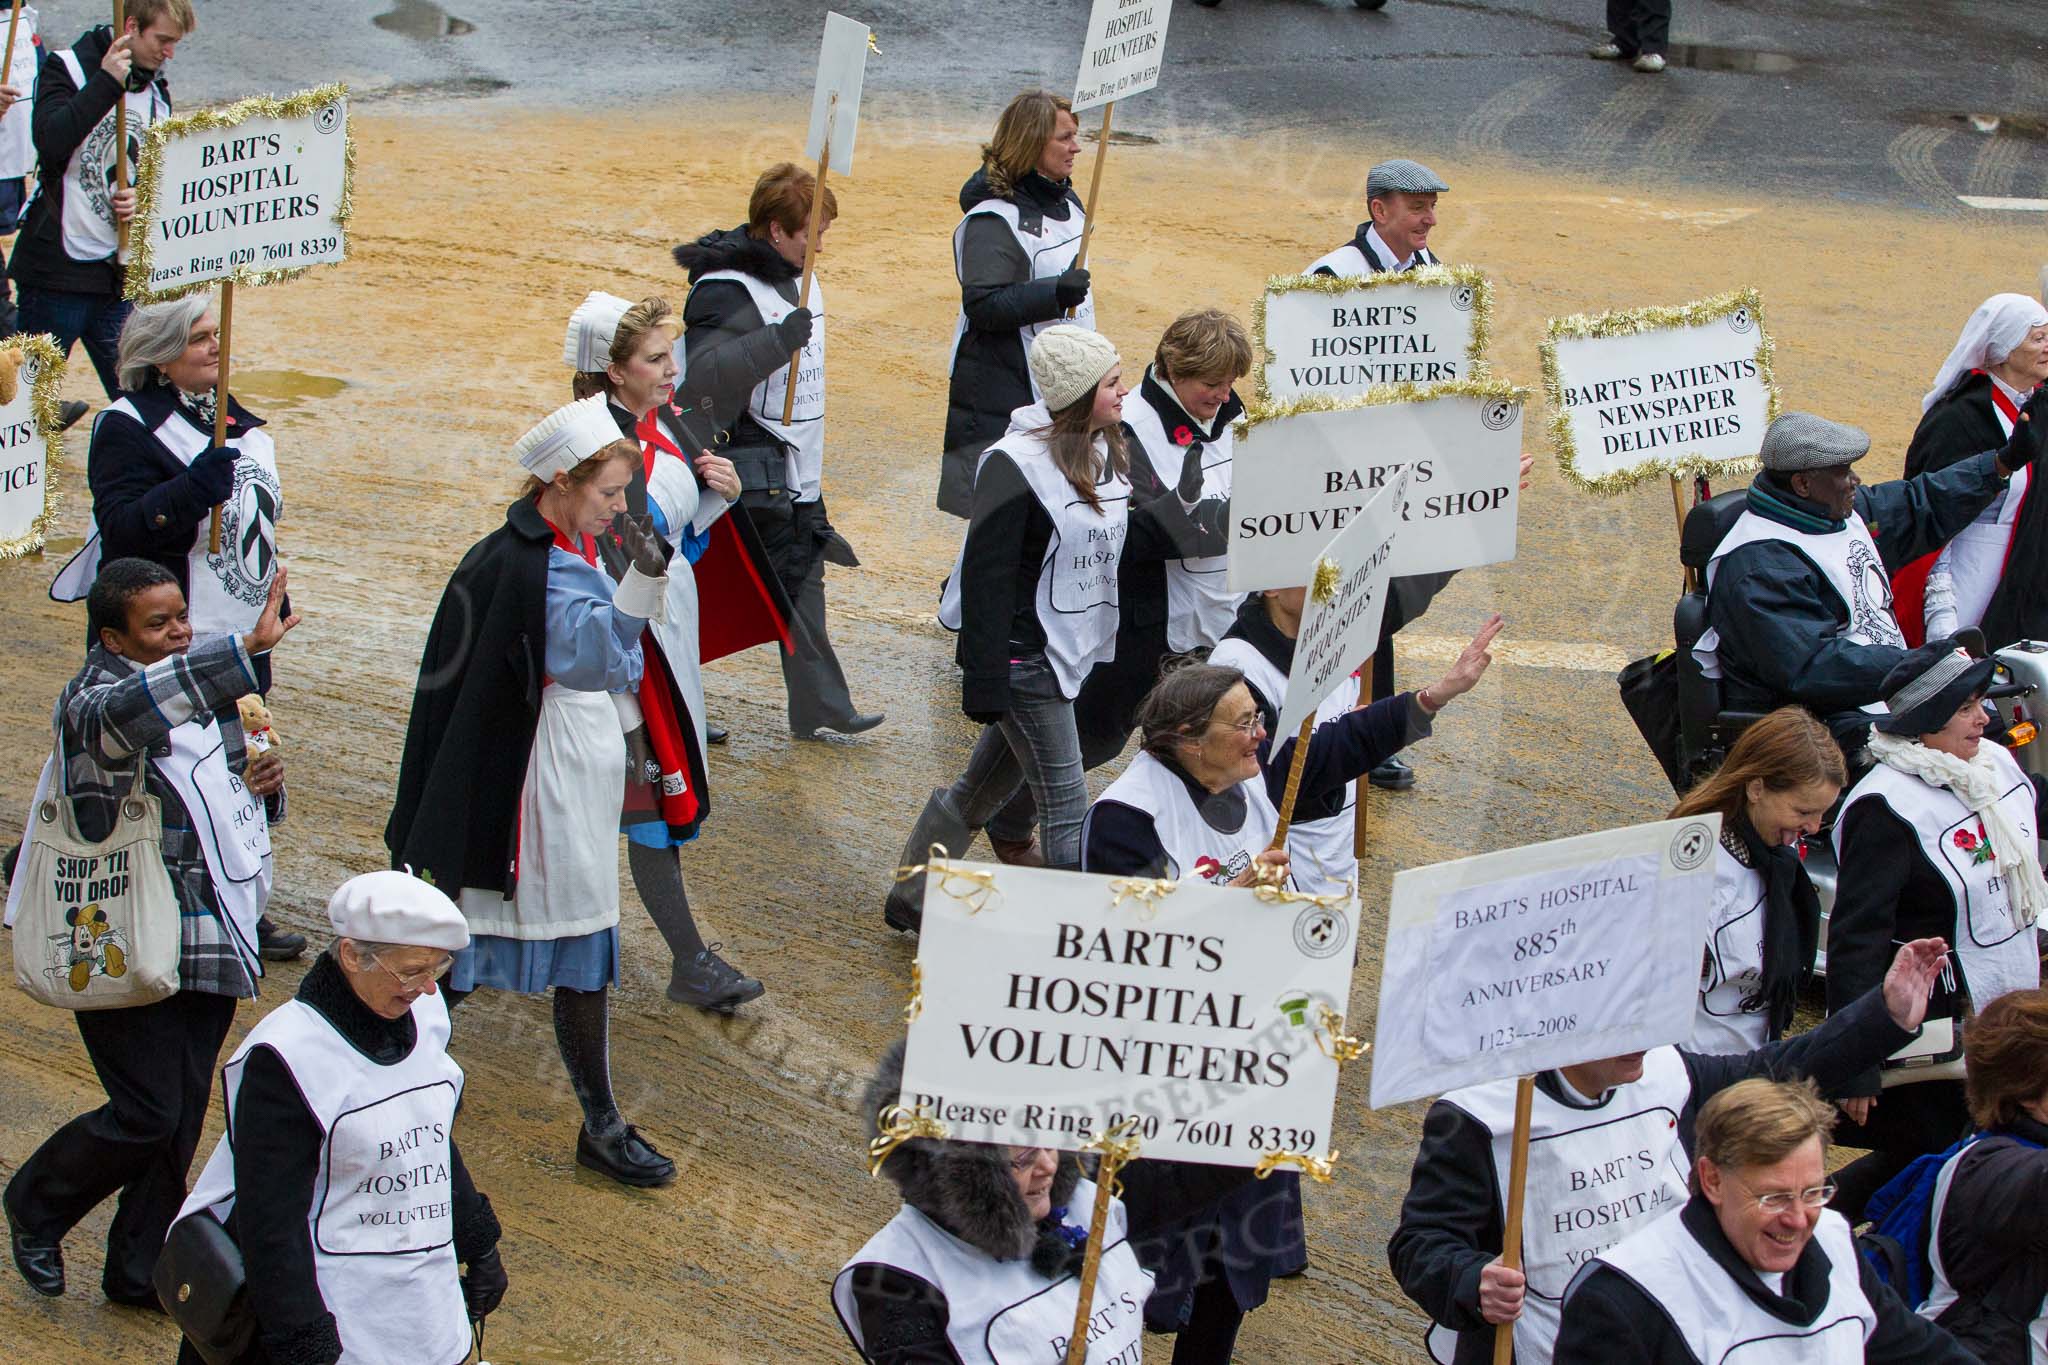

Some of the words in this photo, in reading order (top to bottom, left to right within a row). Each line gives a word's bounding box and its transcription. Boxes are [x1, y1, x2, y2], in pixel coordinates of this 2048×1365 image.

[1105, 8, 1153, 39] HOSPITAL
[1092, 30, 1158, 68] VOLUNTEERS
[1076, 88, 1097, 104] Please
[1099, 82, 1115, 96] Ring
[200, 133, 280, 168] BART'S
[180, 164, 299, 205] HOSPITAL
[161, 193, 319, 241] VOLUNTEERS
[151, 265, 184, 283] lease
[190, 254, 223, 272] Ring
[230, 247, 255, 266] 020
[262, 241, 293, 261] 7601
[300, 236, 337, 256] 8339
[1332, 305, 1417, 328] BART'S
[1311, 333, 1436, 357] HOSPITAL
[1290, 361, 1456, 387] VOLUNTEERS
[1564, 376, 1642, 408] BART'S
[1650, 358, 1756, 394] PATIENTS
[1599, 388, 1737, 429] NEWSPAPER
[1603, 414, 1741, 456] DELIVERIES
[0, 461, 38, 493] ICE
[1323, 460, 1434, 494] BART'S
[1424, 486, 1510, 519] SHOP
[1304, 592, 1371, 675] REQUISITES
[1311, 644, 1346, 693] SHOP
[56, 857, 99, 879] SHOP
[87, 875, 129, 902] DROP
[1455, 896, 1529, 930] BART'S
[1540, 874, 1639, 911] HOSPITAL
[1055, 922, 1225, 973] BART'S
[1513, 918, 1577, 962] 885th
[1007, 973, 1256, 1032] HOSPITAL
[1460, 958, 1612, 1008] ANNIVERSARY
[959, 1022, 1291, 1088] VOLUNTEERS
[377, 1123, 444, 1161] BART'S
[914, 1093, 1007, 1126] Please
[1023, 1103, 1095, 1140] Ring
[1109, 1112, 1159, 1140] 020
[1175, 1117, 1233, 1148] 7601
[1248, 1125, 1316, 1154] 8339
[354, 1160, 451, 1195] HOSITA
[1570, 1150, 1654, 1192] BART'S
[1553, 1182, 1673, 1233] HOSPITAL
[1049, 1291, 1137, 1360] BRT'S
